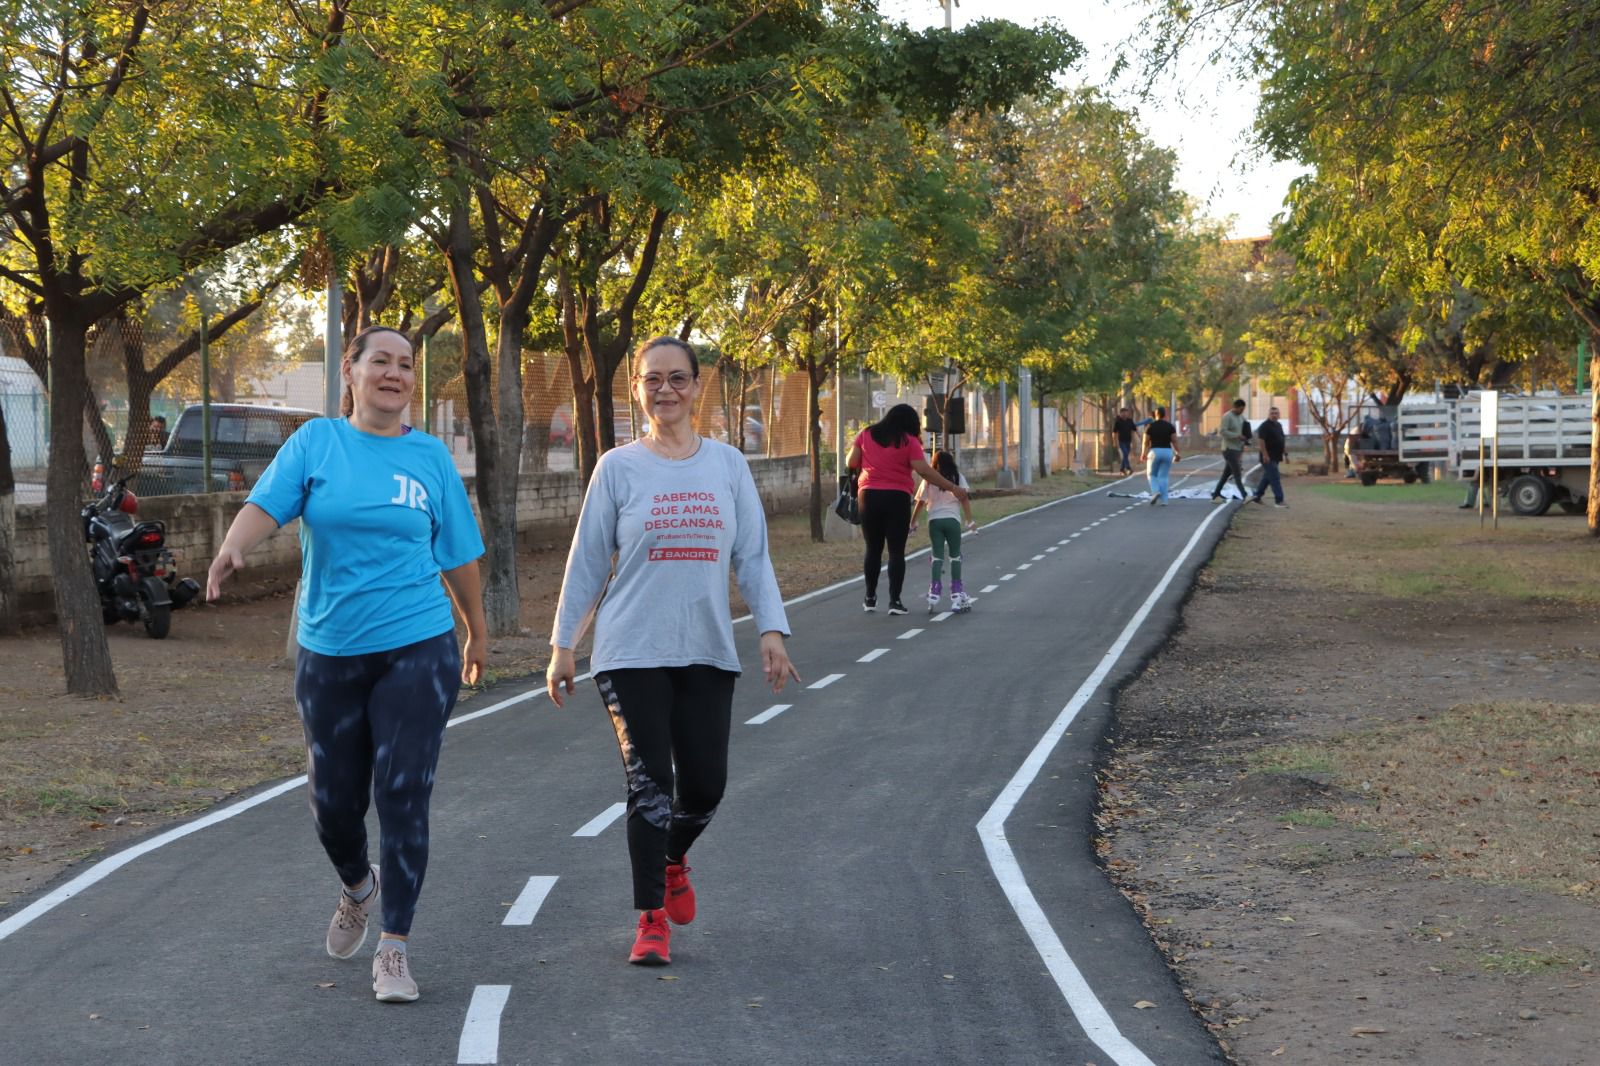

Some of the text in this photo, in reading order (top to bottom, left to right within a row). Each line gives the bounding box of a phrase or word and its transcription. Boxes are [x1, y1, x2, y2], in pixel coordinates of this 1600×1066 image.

[391, 474, 427, 510] JR
[653, 492, 715, 503] SABEMOS
[651, 505, 719, 516] QUE AMAS
[644, 518, 725, 531] DESCANSAR.
